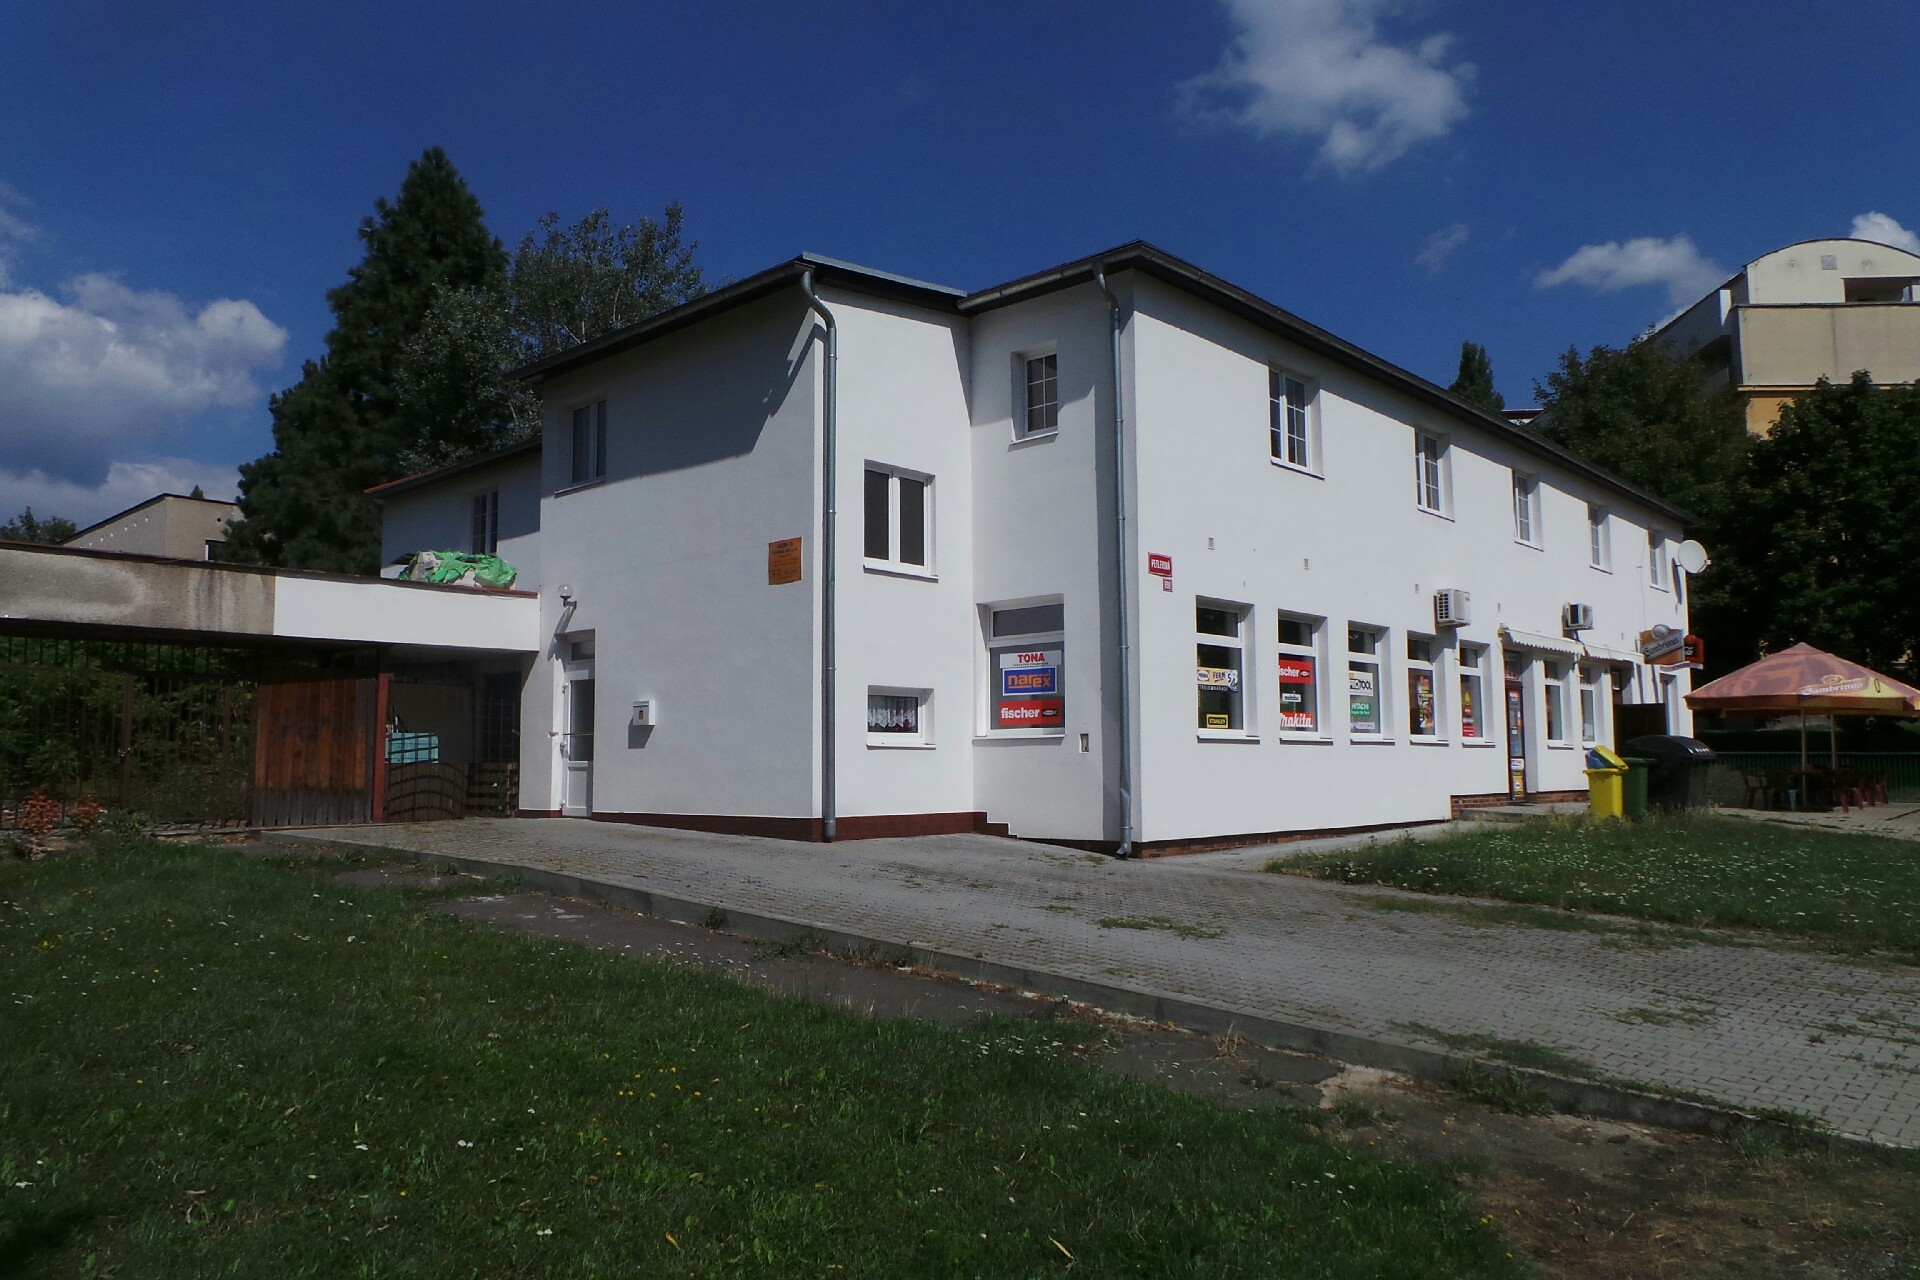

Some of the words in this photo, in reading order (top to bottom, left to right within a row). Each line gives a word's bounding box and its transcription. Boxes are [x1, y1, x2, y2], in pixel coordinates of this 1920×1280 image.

[1017, 653, 1045, 663] TONA
[1008, 674, 1051, 688] narex
[1802, 683, 1863, 695] Gambrinus
[1001, 707, 1040, 718] fischer
